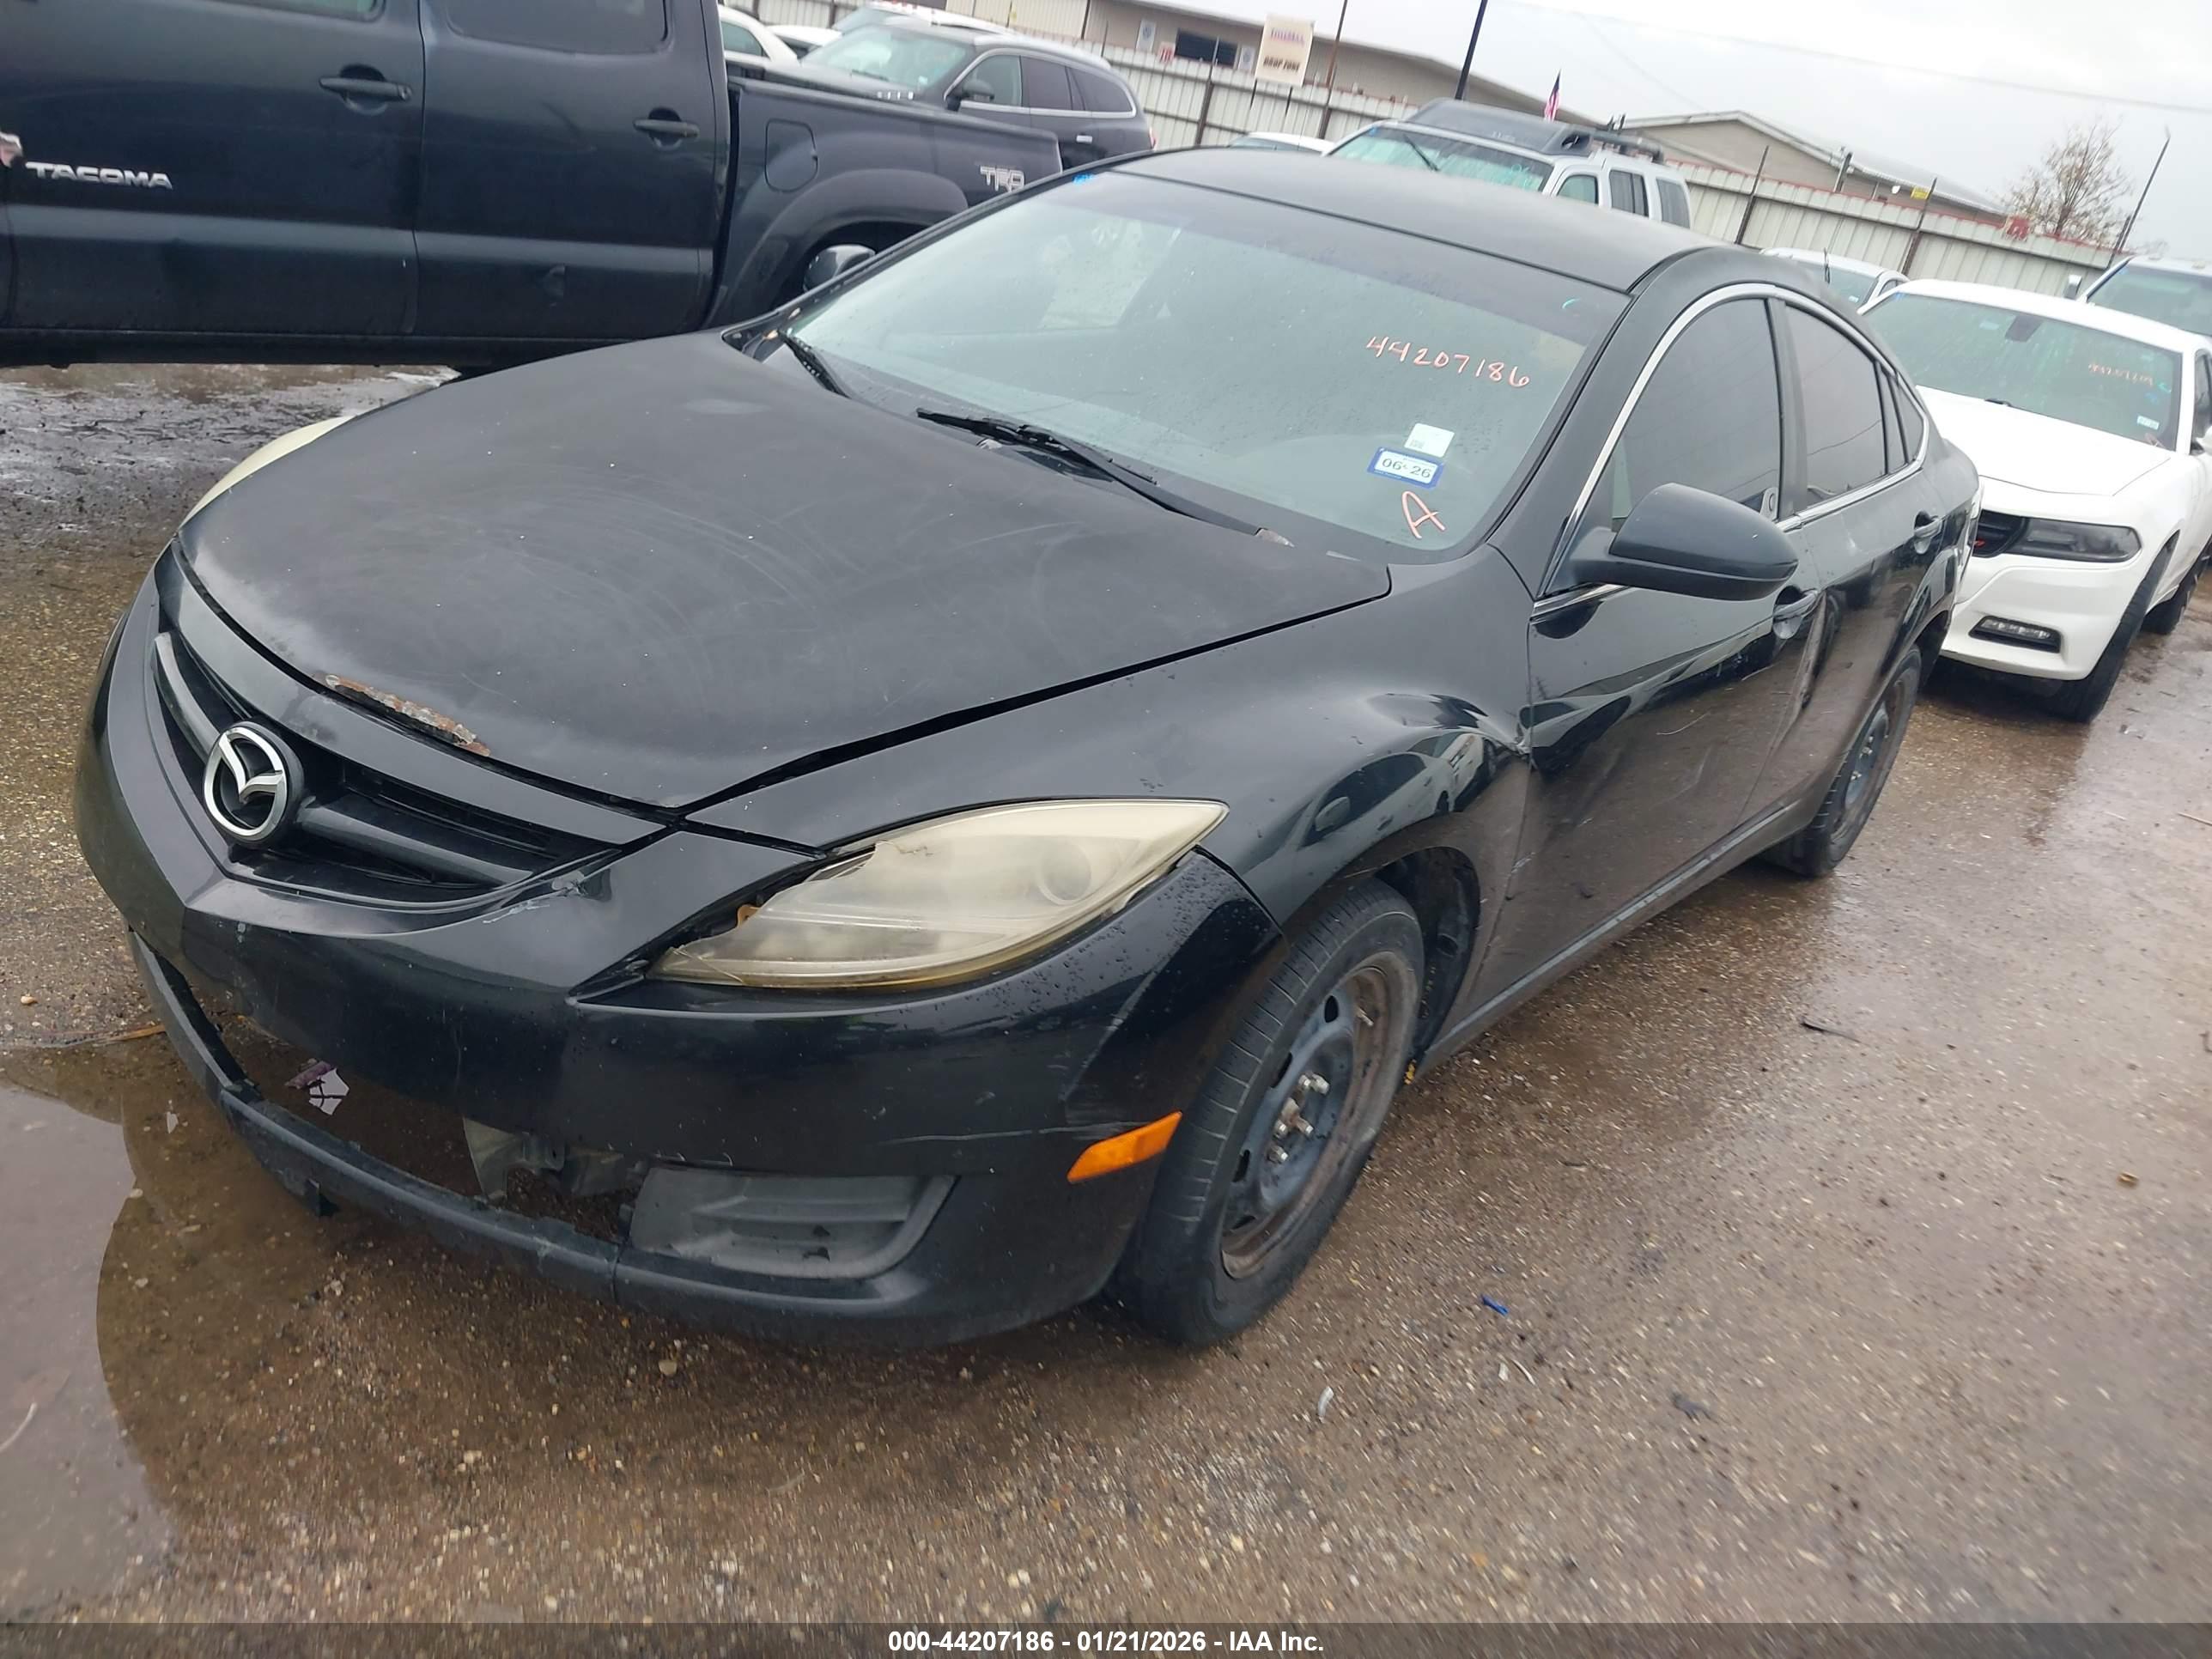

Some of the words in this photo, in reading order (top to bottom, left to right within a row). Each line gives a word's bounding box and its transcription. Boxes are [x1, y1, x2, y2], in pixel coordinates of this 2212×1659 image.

[25, 161, 173, 190] TACOMA
[1365, 336, 1531, 387] 44207186
[1401, 490, 1447, 539] A
